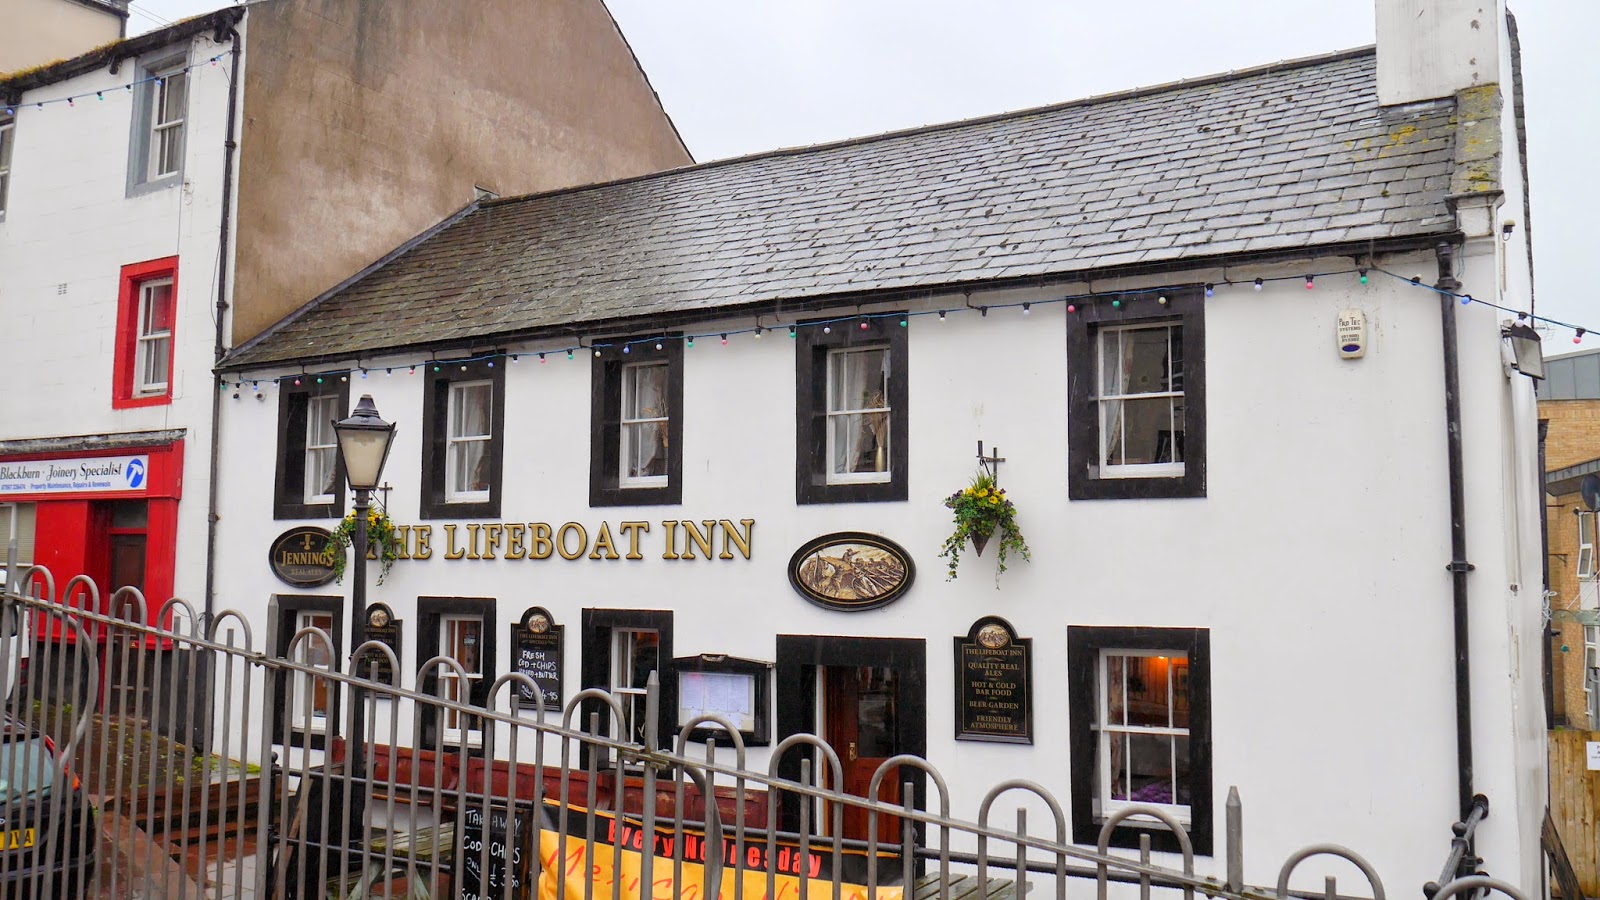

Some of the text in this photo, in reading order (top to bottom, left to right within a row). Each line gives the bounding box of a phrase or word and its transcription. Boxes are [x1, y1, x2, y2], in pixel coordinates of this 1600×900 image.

[0, 461, 122, 481] Blackburn Joinery Specialist
[443, 521, 649, 560] LIFEBOAT
[662, 518, 755, 560] INN
[281, 550, 336, 567] JENNINGS
[522, 650, 545, 660] FRESH
[968, 662, 1019, 670] QUALITY REAL
[971, 681, 987, 689] HOT
[975, 688, 990, 696] BAR
[988, 701, 1019, 709] GARDEN
[976, 715, 1012, 723] FRIENDLY
[970, 722, 1019, 731] ATMOSPHERE
